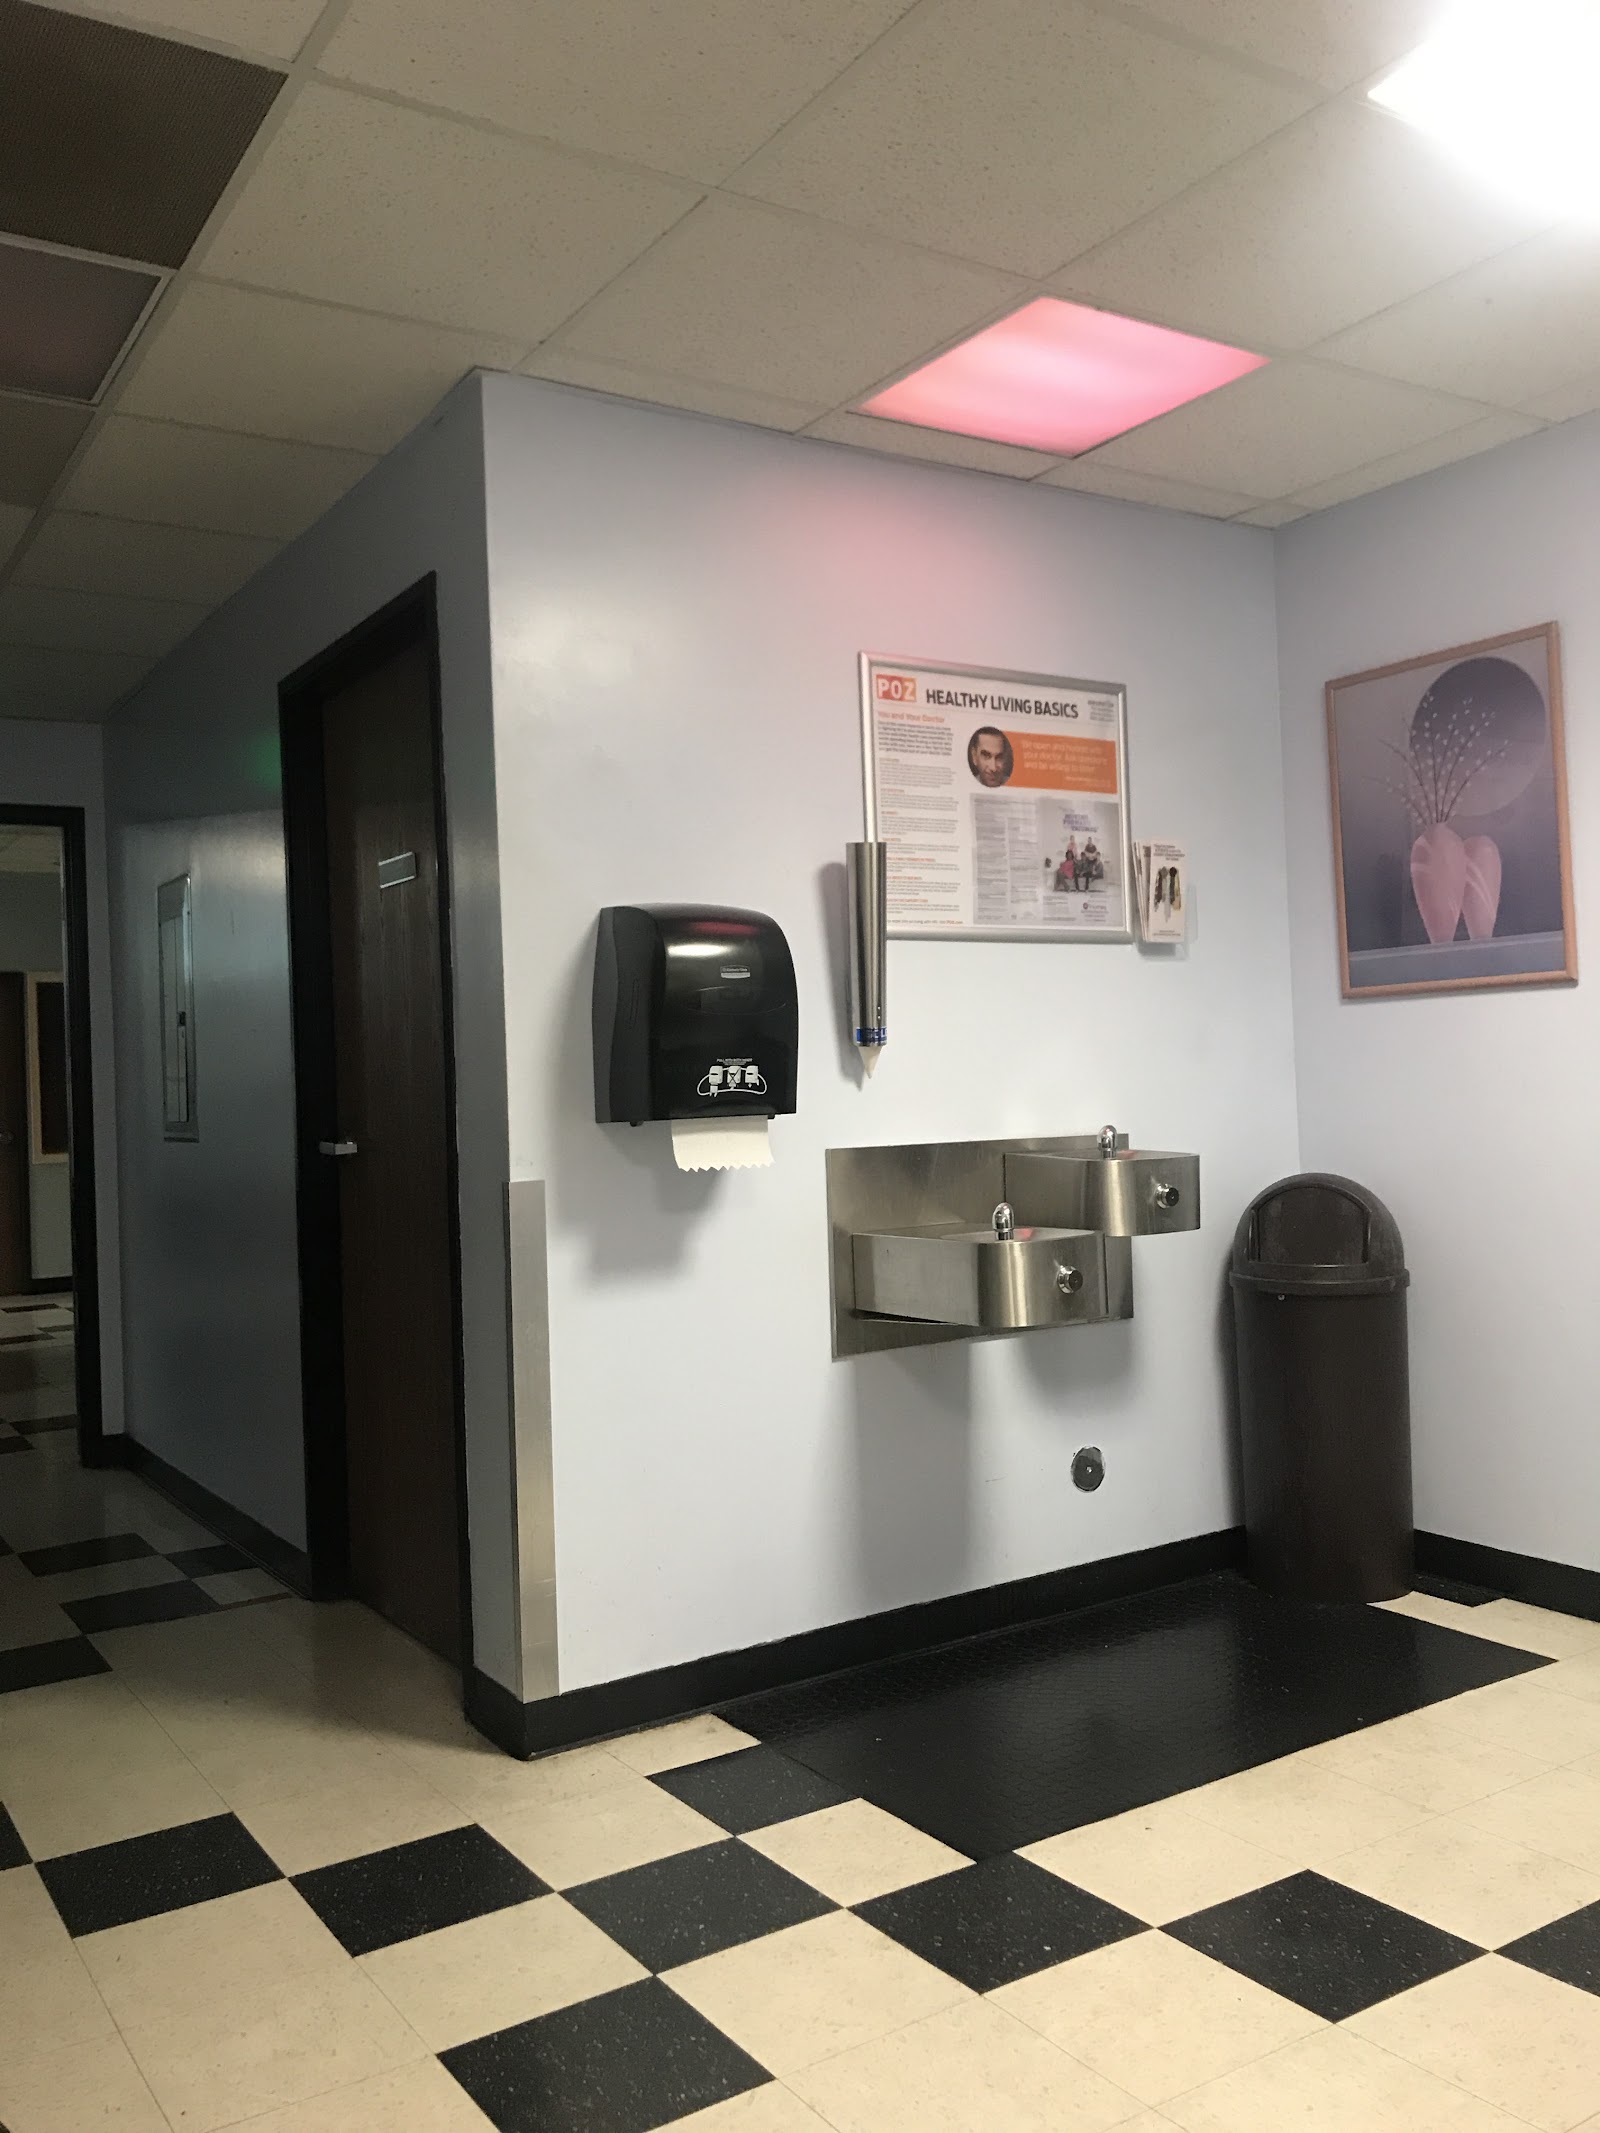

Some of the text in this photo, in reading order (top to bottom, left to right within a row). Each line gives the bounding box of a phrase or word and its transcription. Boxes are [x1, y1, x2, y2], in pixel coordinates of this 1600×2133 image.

[878, 678, 915, 701] POZ
[926, 689, 988, 709] HEALTHY
[990, 695, 1032, 714] LIVING
[1034, 700, 1079, 719] BASICS
